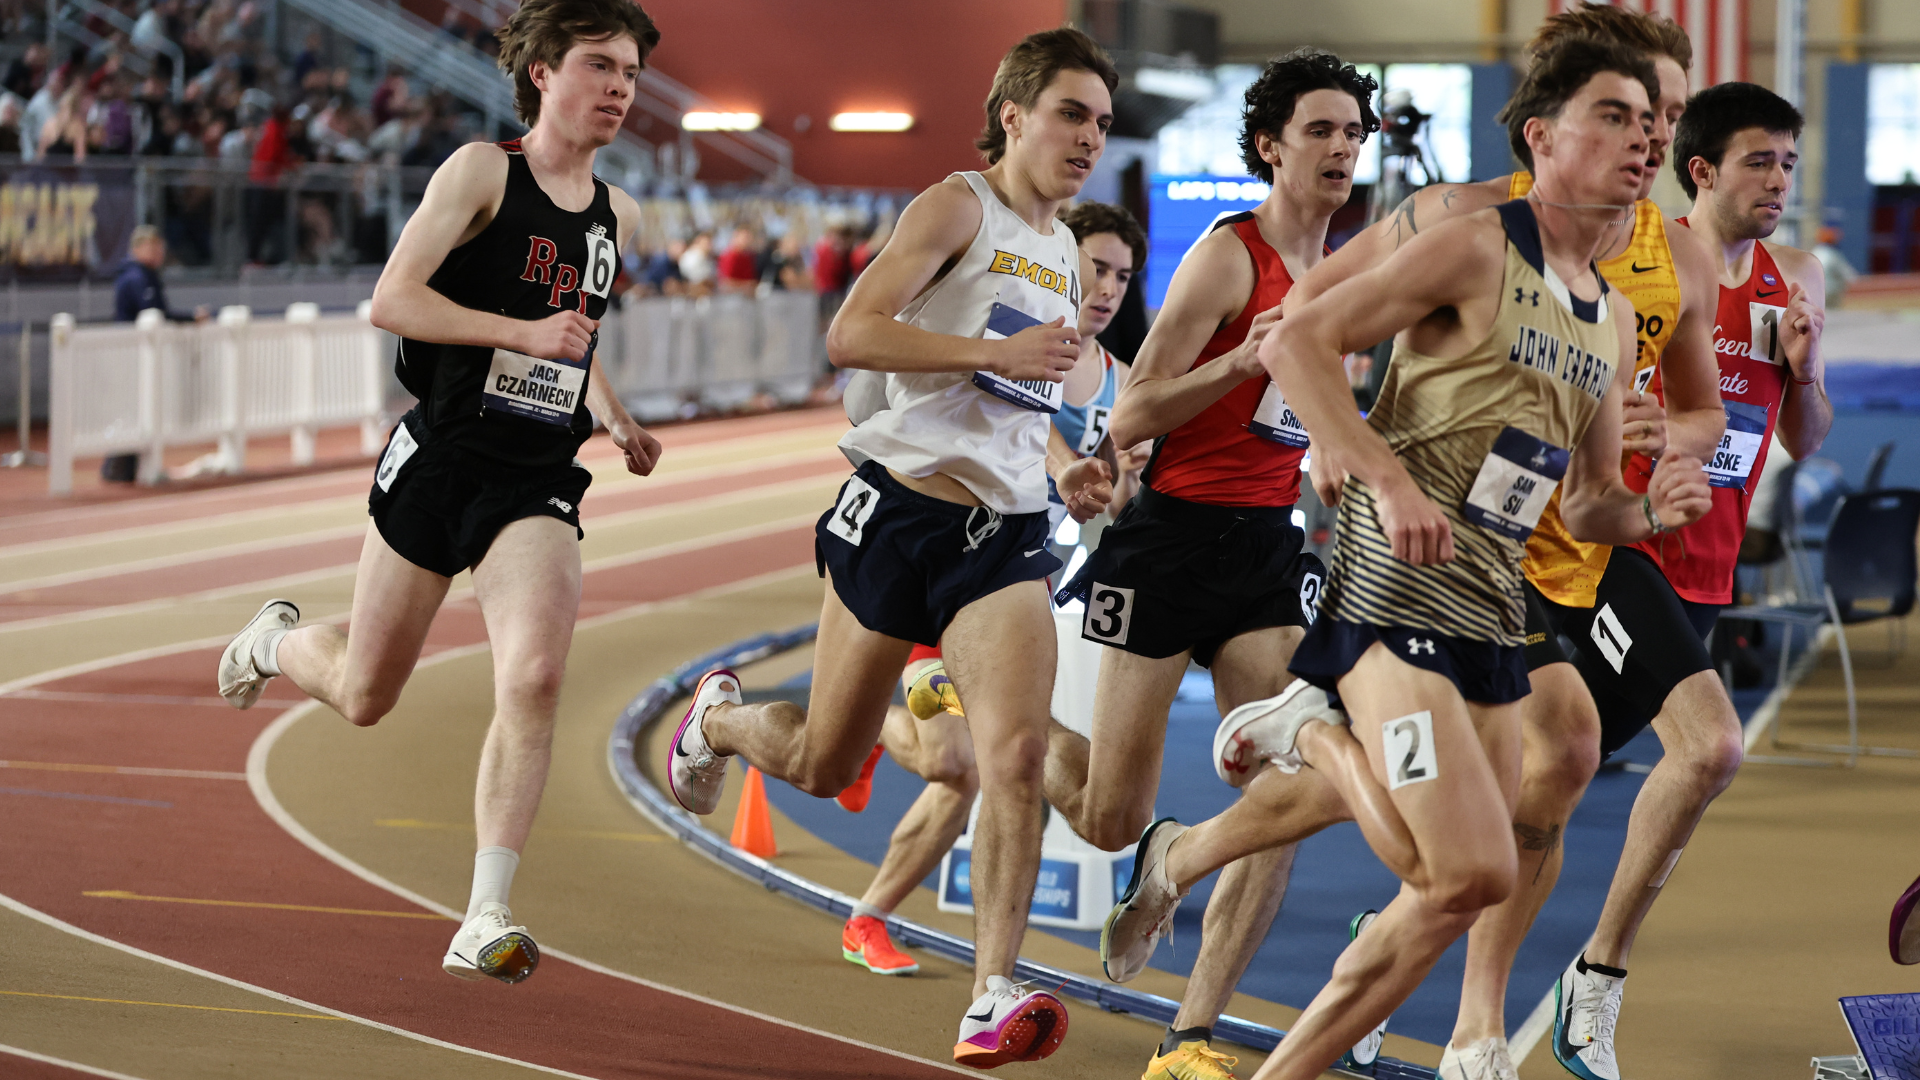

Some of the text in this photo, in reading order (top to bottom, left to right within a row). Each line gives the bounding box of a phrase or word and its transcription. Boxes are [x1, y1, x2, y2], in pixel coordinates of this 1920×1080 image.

[593, 239, 609, 292] 6
[1070, 269, 1079, 319] 4
[1509, 326, 1559, 374] JOHN
[1761, 309, 1777, 361] 1
[495, 374, 575, 408] CZARNECKI
[528, 364, 561, 383] JACK
[1087, 410, 1107, 451] 5
[379, 434, 411, 482] 6
[1502, 494, 1525, 516] SU
[1512, 475, 1537, 495] SAM
[839, 490, 871, 538] 4
[1091, 589, 1125, 638] 3
[1598, 615, 1624, 657] 1
[1394, 720, 1426, 782] 2
